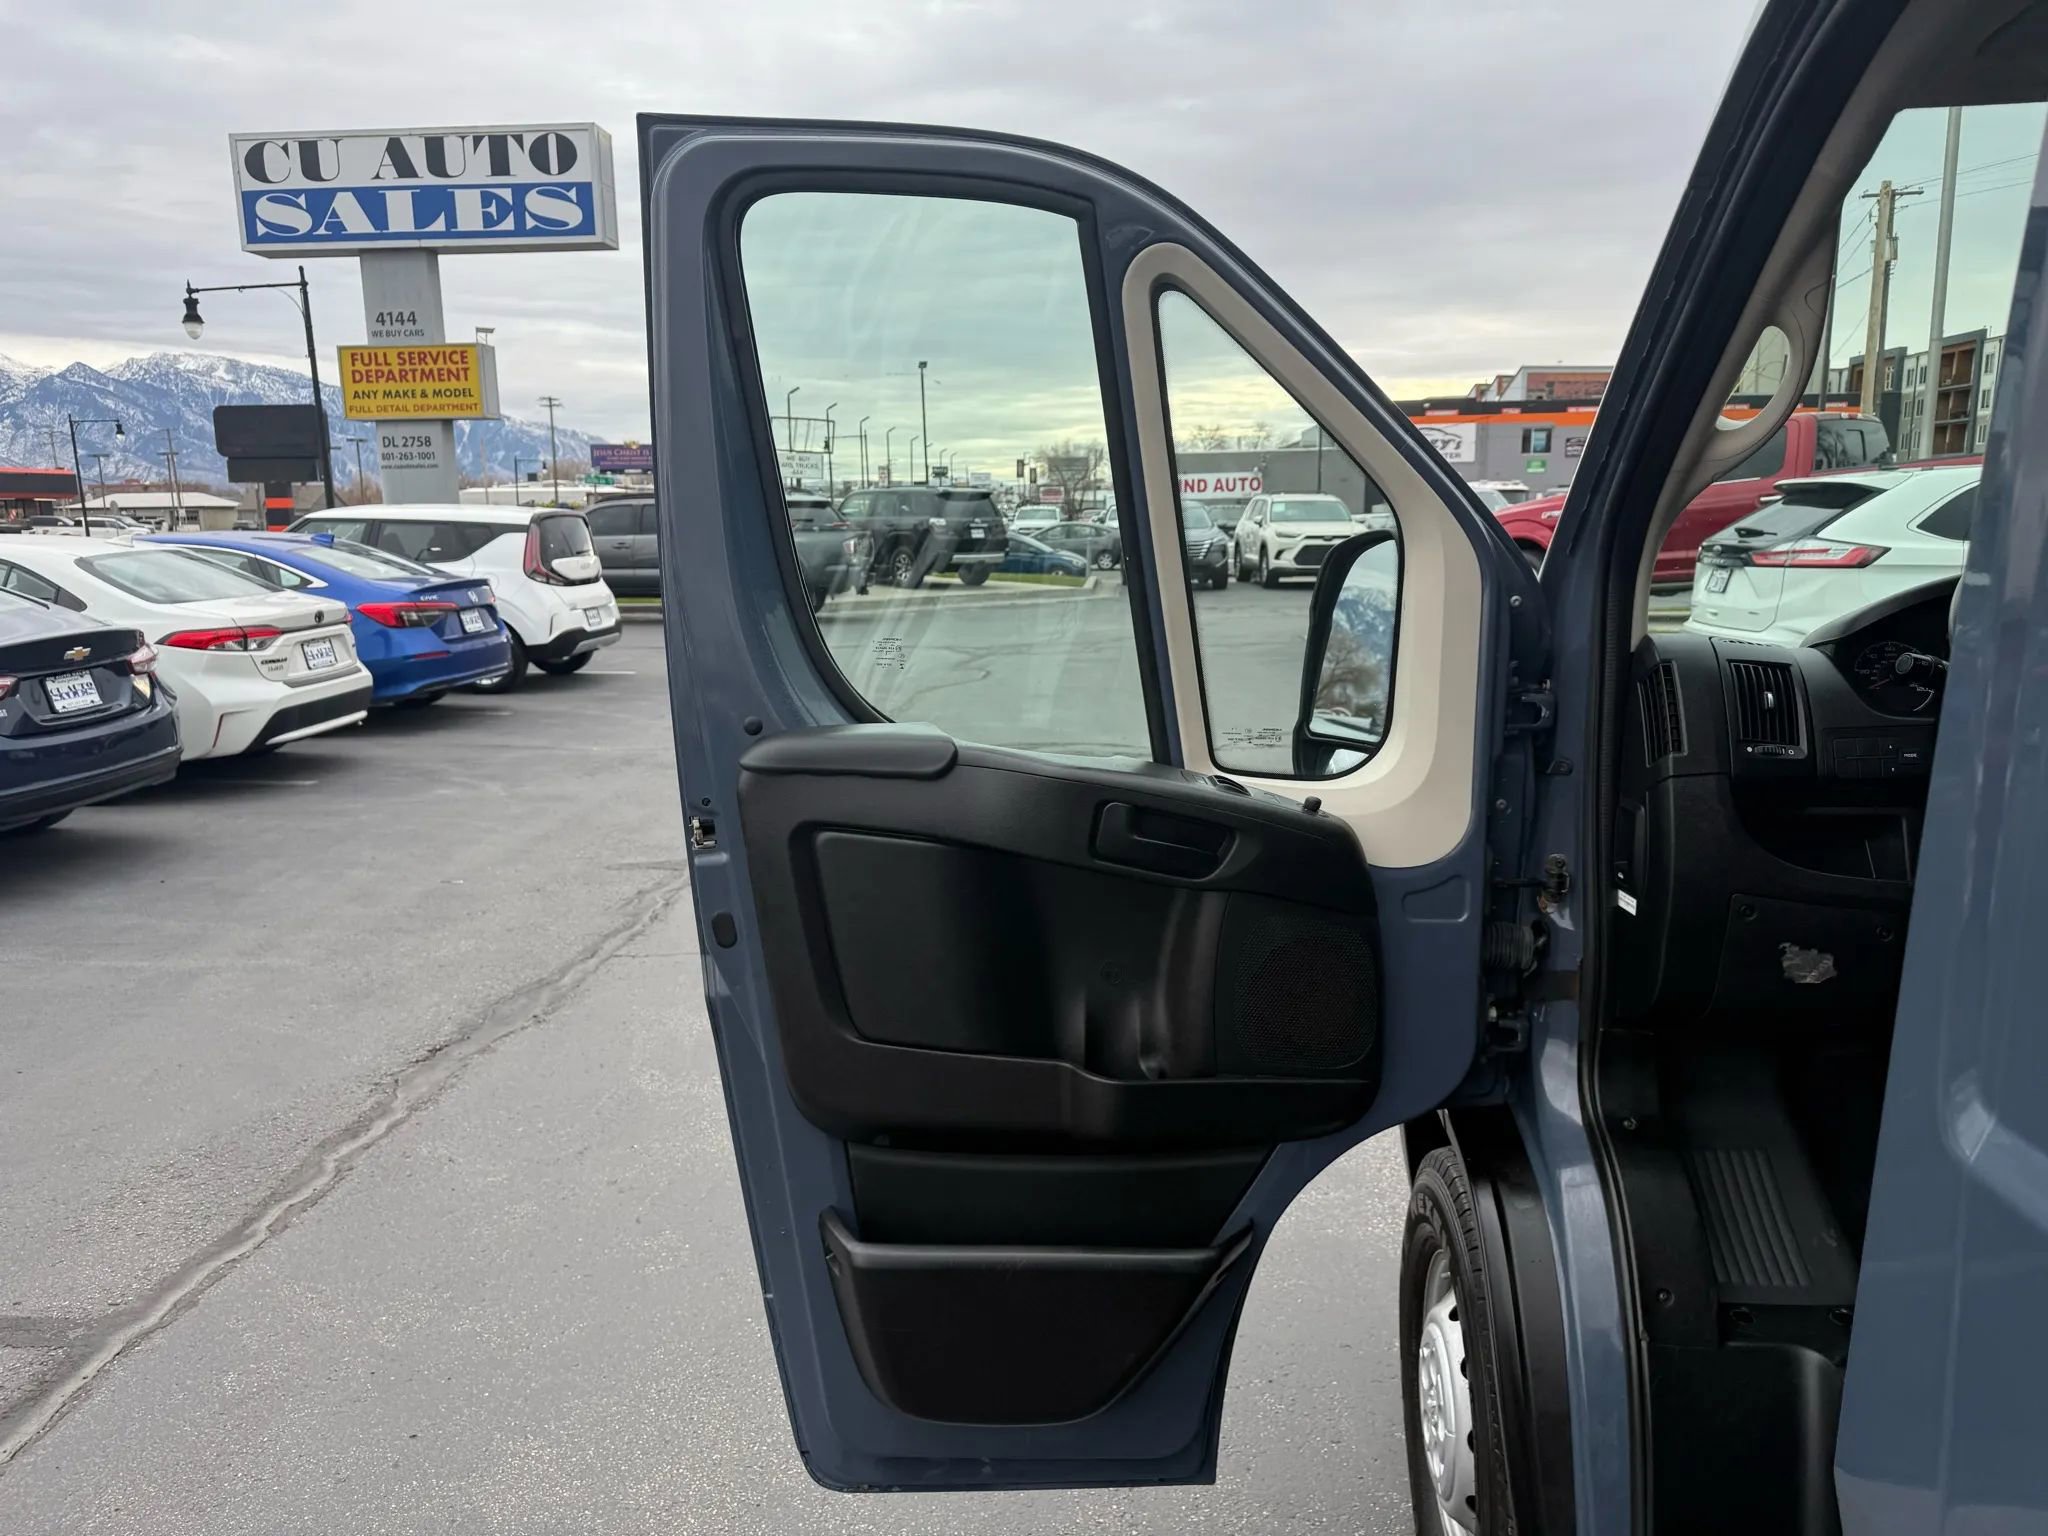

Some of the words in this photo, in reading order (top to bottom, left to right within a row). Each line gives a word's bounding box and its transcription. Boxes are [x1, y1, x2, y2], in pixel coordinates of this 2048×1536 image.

[244, 138, 344, 184] CU
[372, 132, 578, 180] AUTO
[255, 186, 584, 237] SALES
[375, 311, 417, 326] 4144
[371, 330, 384, 338] WE
[385, 329, 402, 337] BUY
[403, 329, 424, 337] CARS
[350, 351, 392, 367] FULL
[397, 350, 468, 366] SERVICE
[351, 367, 470, 384] DEPARTMENT
[353, 389, 379, 400] ANY
[382, 389, 417, 399] MAKE
[420, 389, 428, 399] &
[432, 388, 474, 399] MODEL
[349, 405, 373, 414] FULL
[376, 404, 410, 413] DETAIL
[413, 403, 479, 413] DEPARTMENT
[382, 436, 399, 448] DL
[401, 435, 432, 448] 2758
[1180, 479, 1208, 493] ND
[1213, 477, 1261, 492] AUTO
